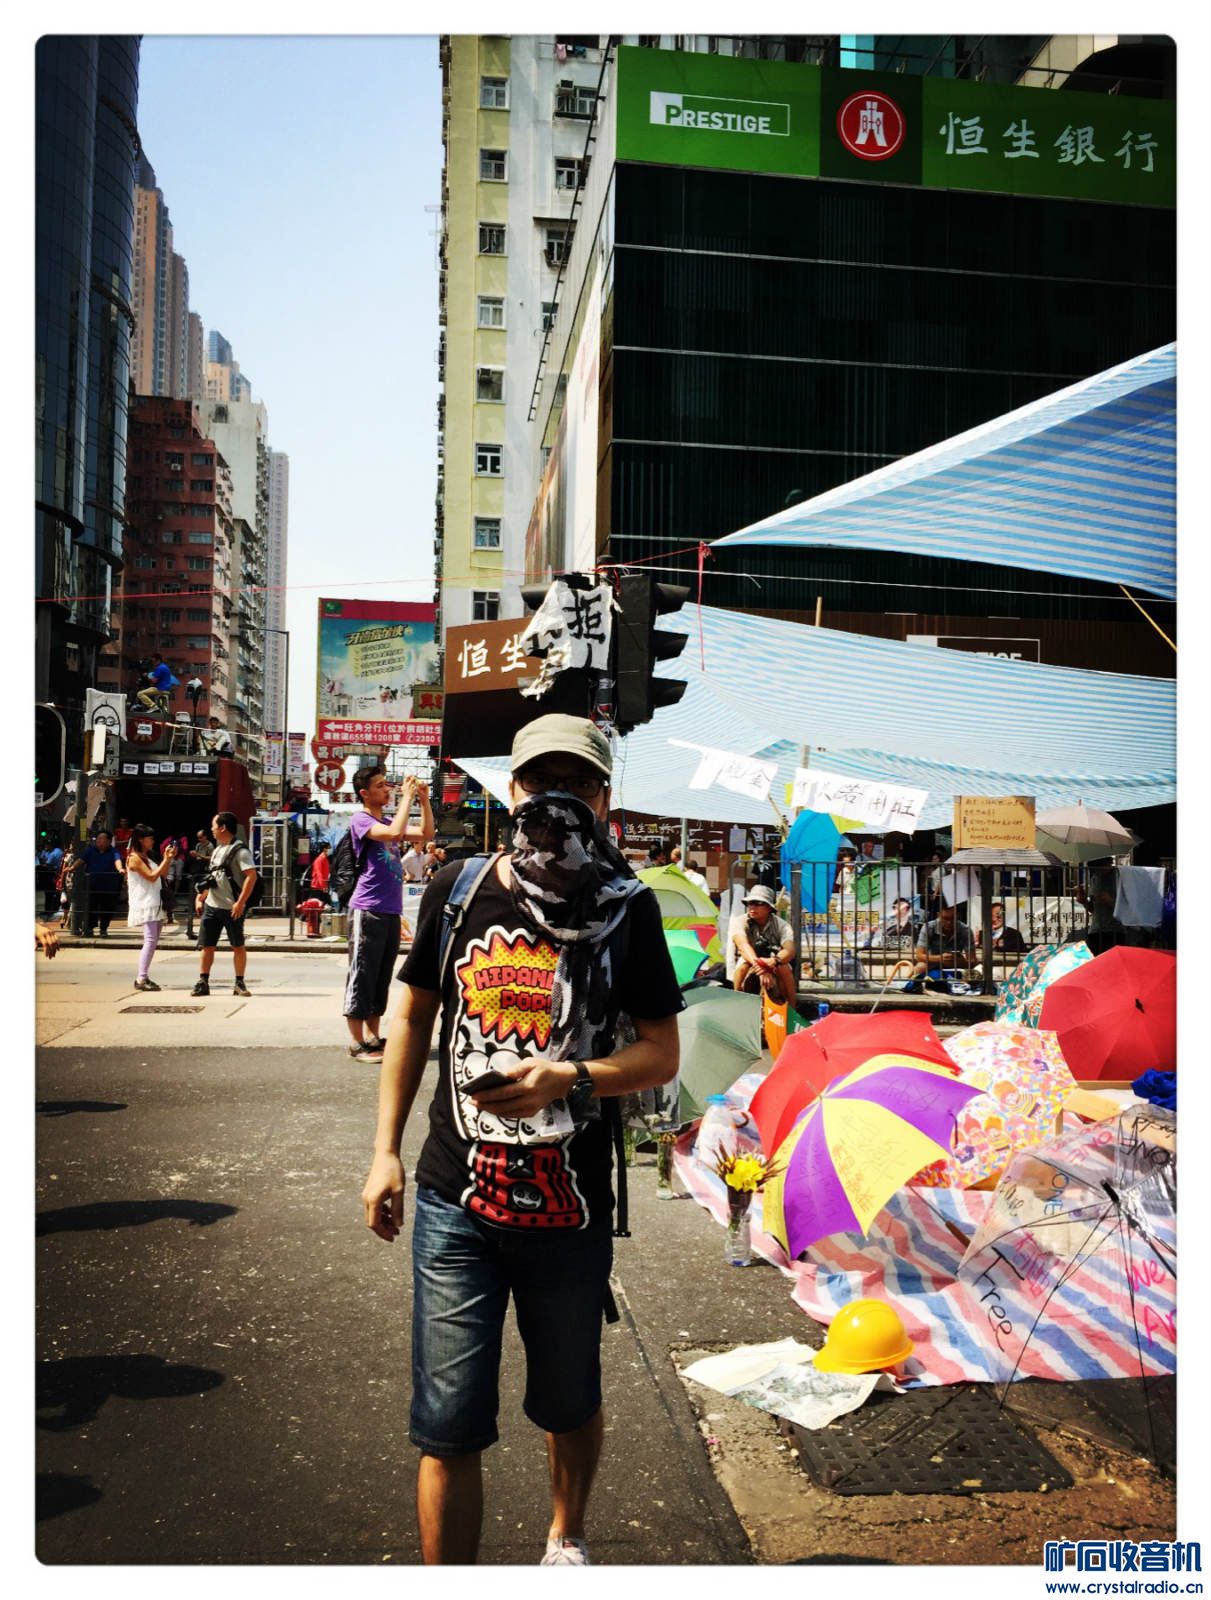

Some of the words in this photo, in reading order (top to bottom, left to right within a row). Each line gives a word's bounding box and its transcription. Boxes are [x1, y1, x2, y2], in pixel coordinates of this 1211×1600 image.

[665, 104, 771, 134] PRESTIGE
[939, 111, 1159, 173] 恒生銀行
